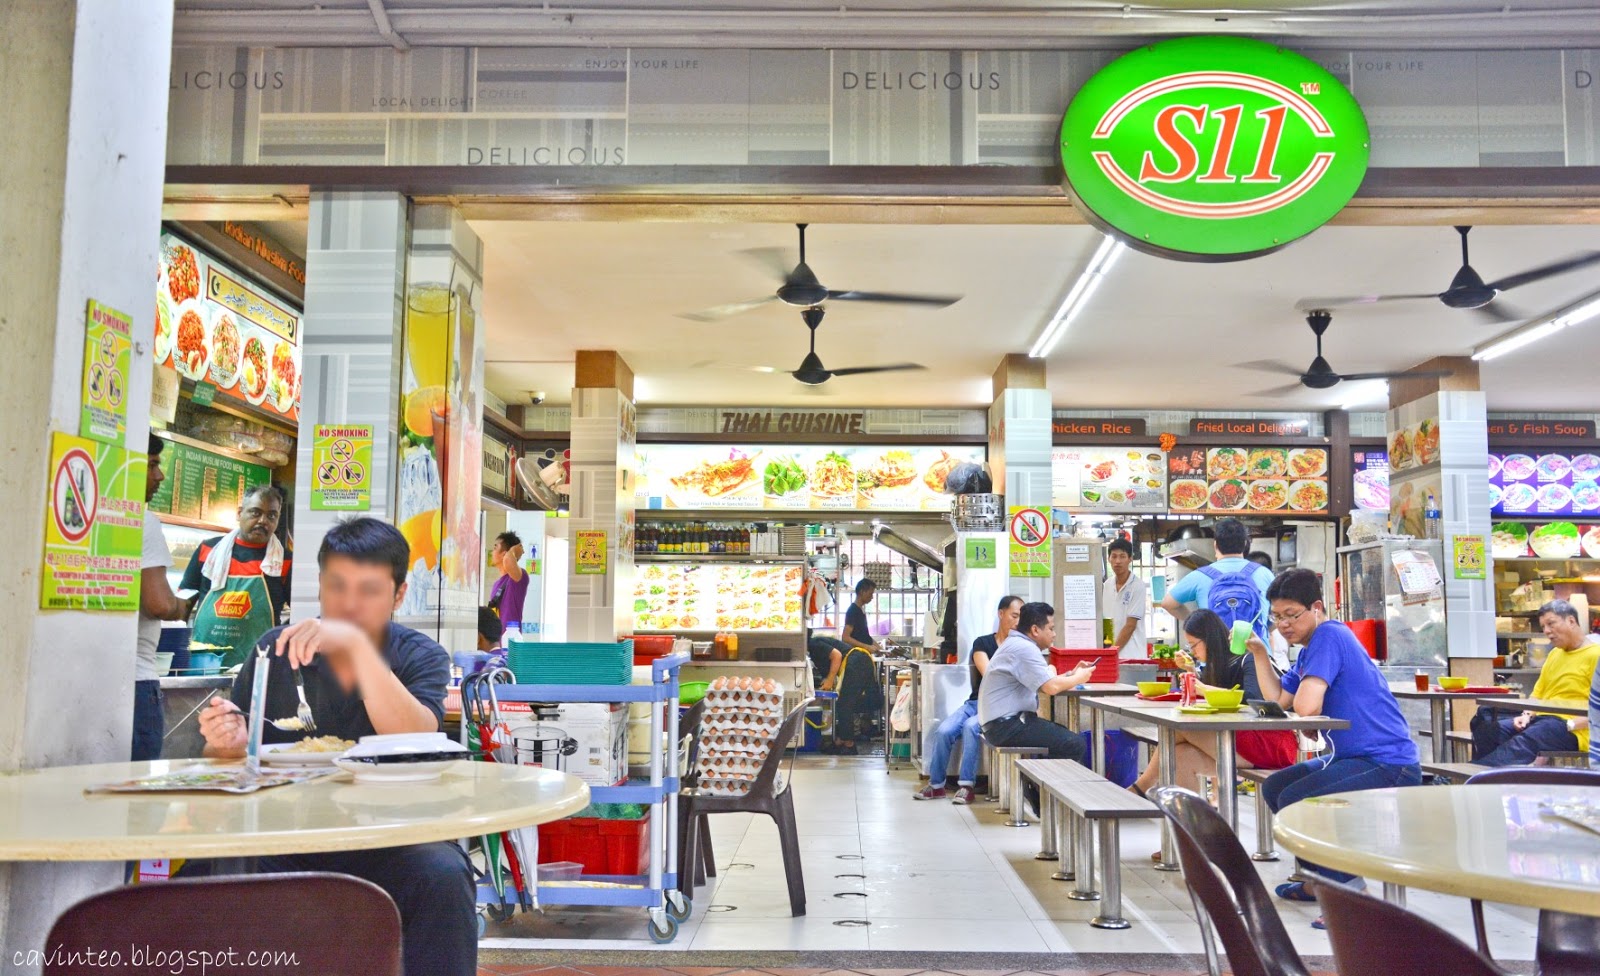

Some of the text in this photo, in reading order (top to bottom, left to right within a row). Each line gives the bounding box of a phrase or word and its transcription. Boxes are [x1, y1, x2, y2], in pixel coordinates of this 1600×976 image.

[585, 59, 700, 70] ENJOY YOUR LIFE
[1357, 61, 1392, 71] YOUR
[1398, 61, 1424, 71] LIFE
[842, 71, 1001, 91] DELICIOUS
[1575, 70, 1592, 88] D
[1300, 82, 1321, 95] TM
[372, 97, 475, 107] LOCAL DELIGHT
[1138, 102, 1290, 183] S11
[467, 147, 626, 166] DELICIOUS
[92, 308, 130, 335] NO SMOKING
[722, 412, 864, 434] THAI CUISINE
[1052, 423, 1132, 434] hicken Rice
[1196, 422, 1302, 437] Fried Local Delights
[1487, 423, 1587, 436] en & Fish Soup
[319, 429, 369, 437] NO SMOKING
[185, 449, 245, 474] INDIAN MUSLIM FOOD MENU
